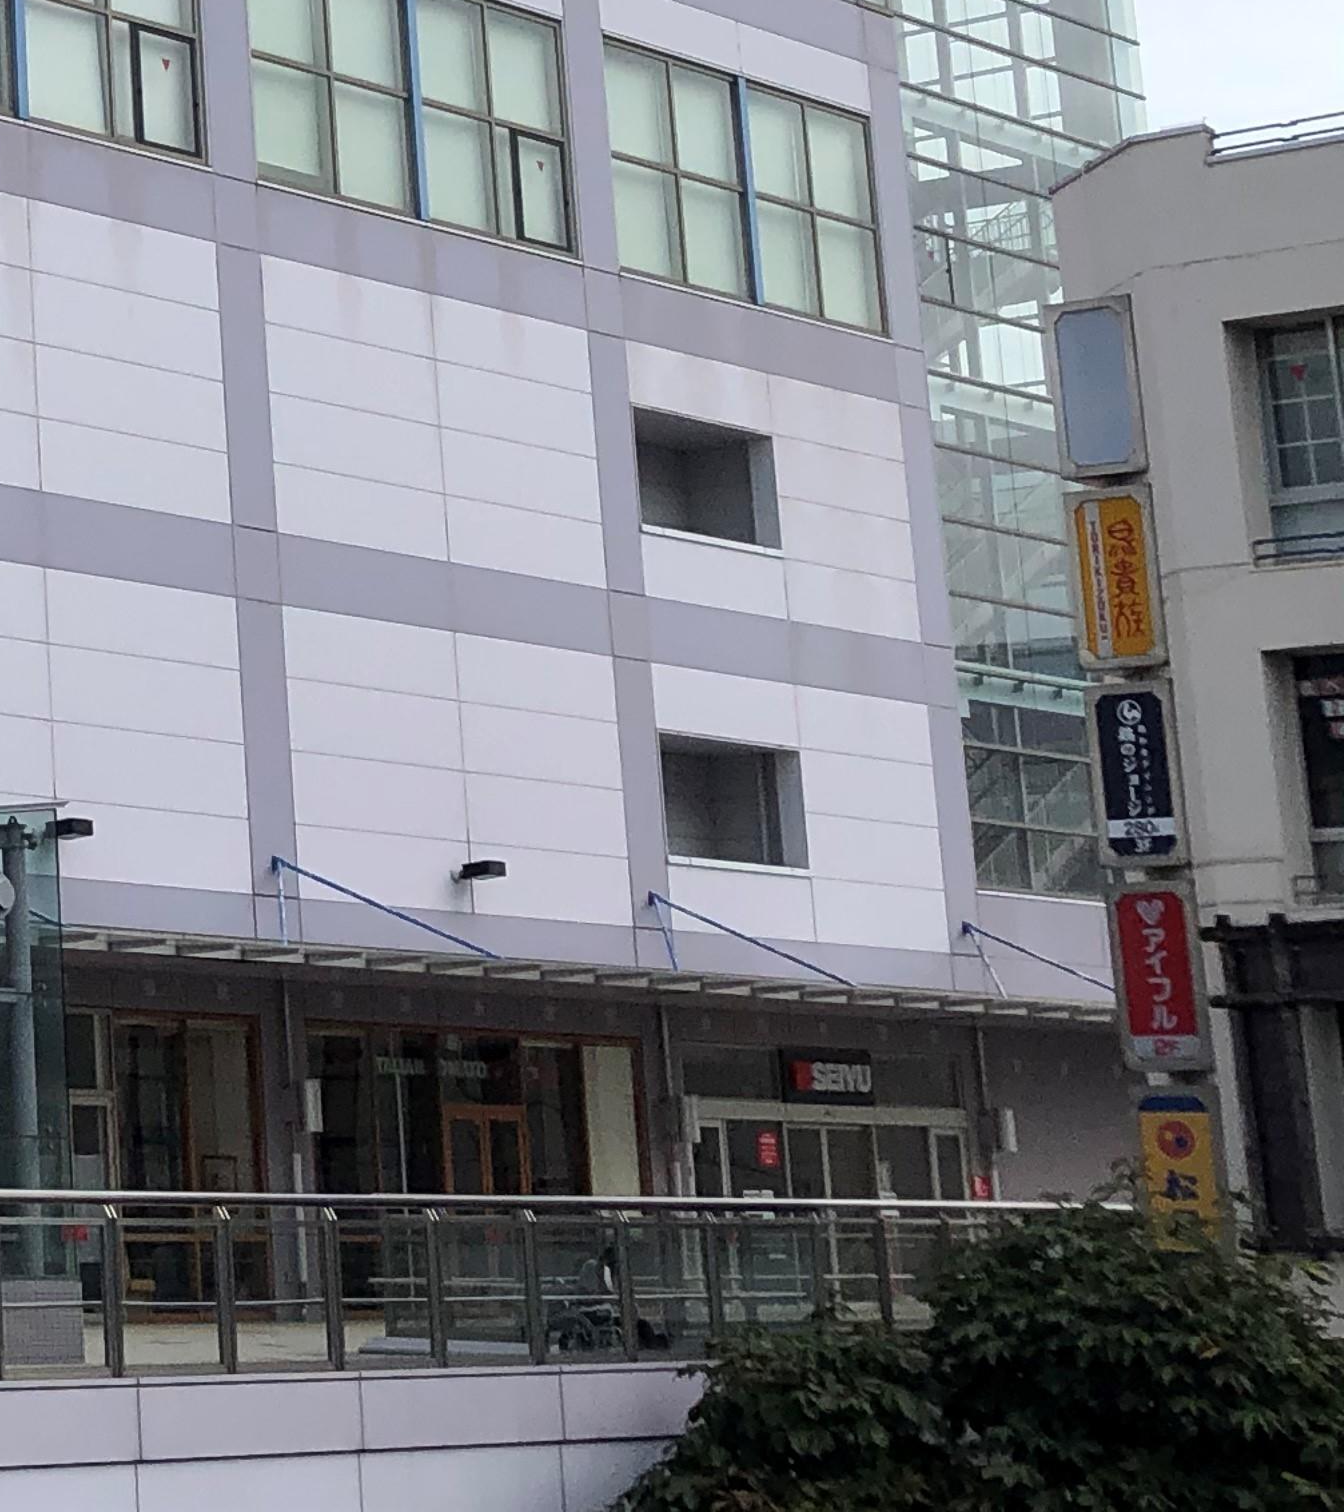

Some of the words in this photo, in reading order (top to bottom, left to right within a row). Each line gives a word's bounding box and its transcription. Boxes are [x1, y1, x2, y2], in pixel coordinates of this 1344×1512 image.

[1141, 927, 1179, 1031] アイフル
[812, 1061, 872, 1093] SEIYU
